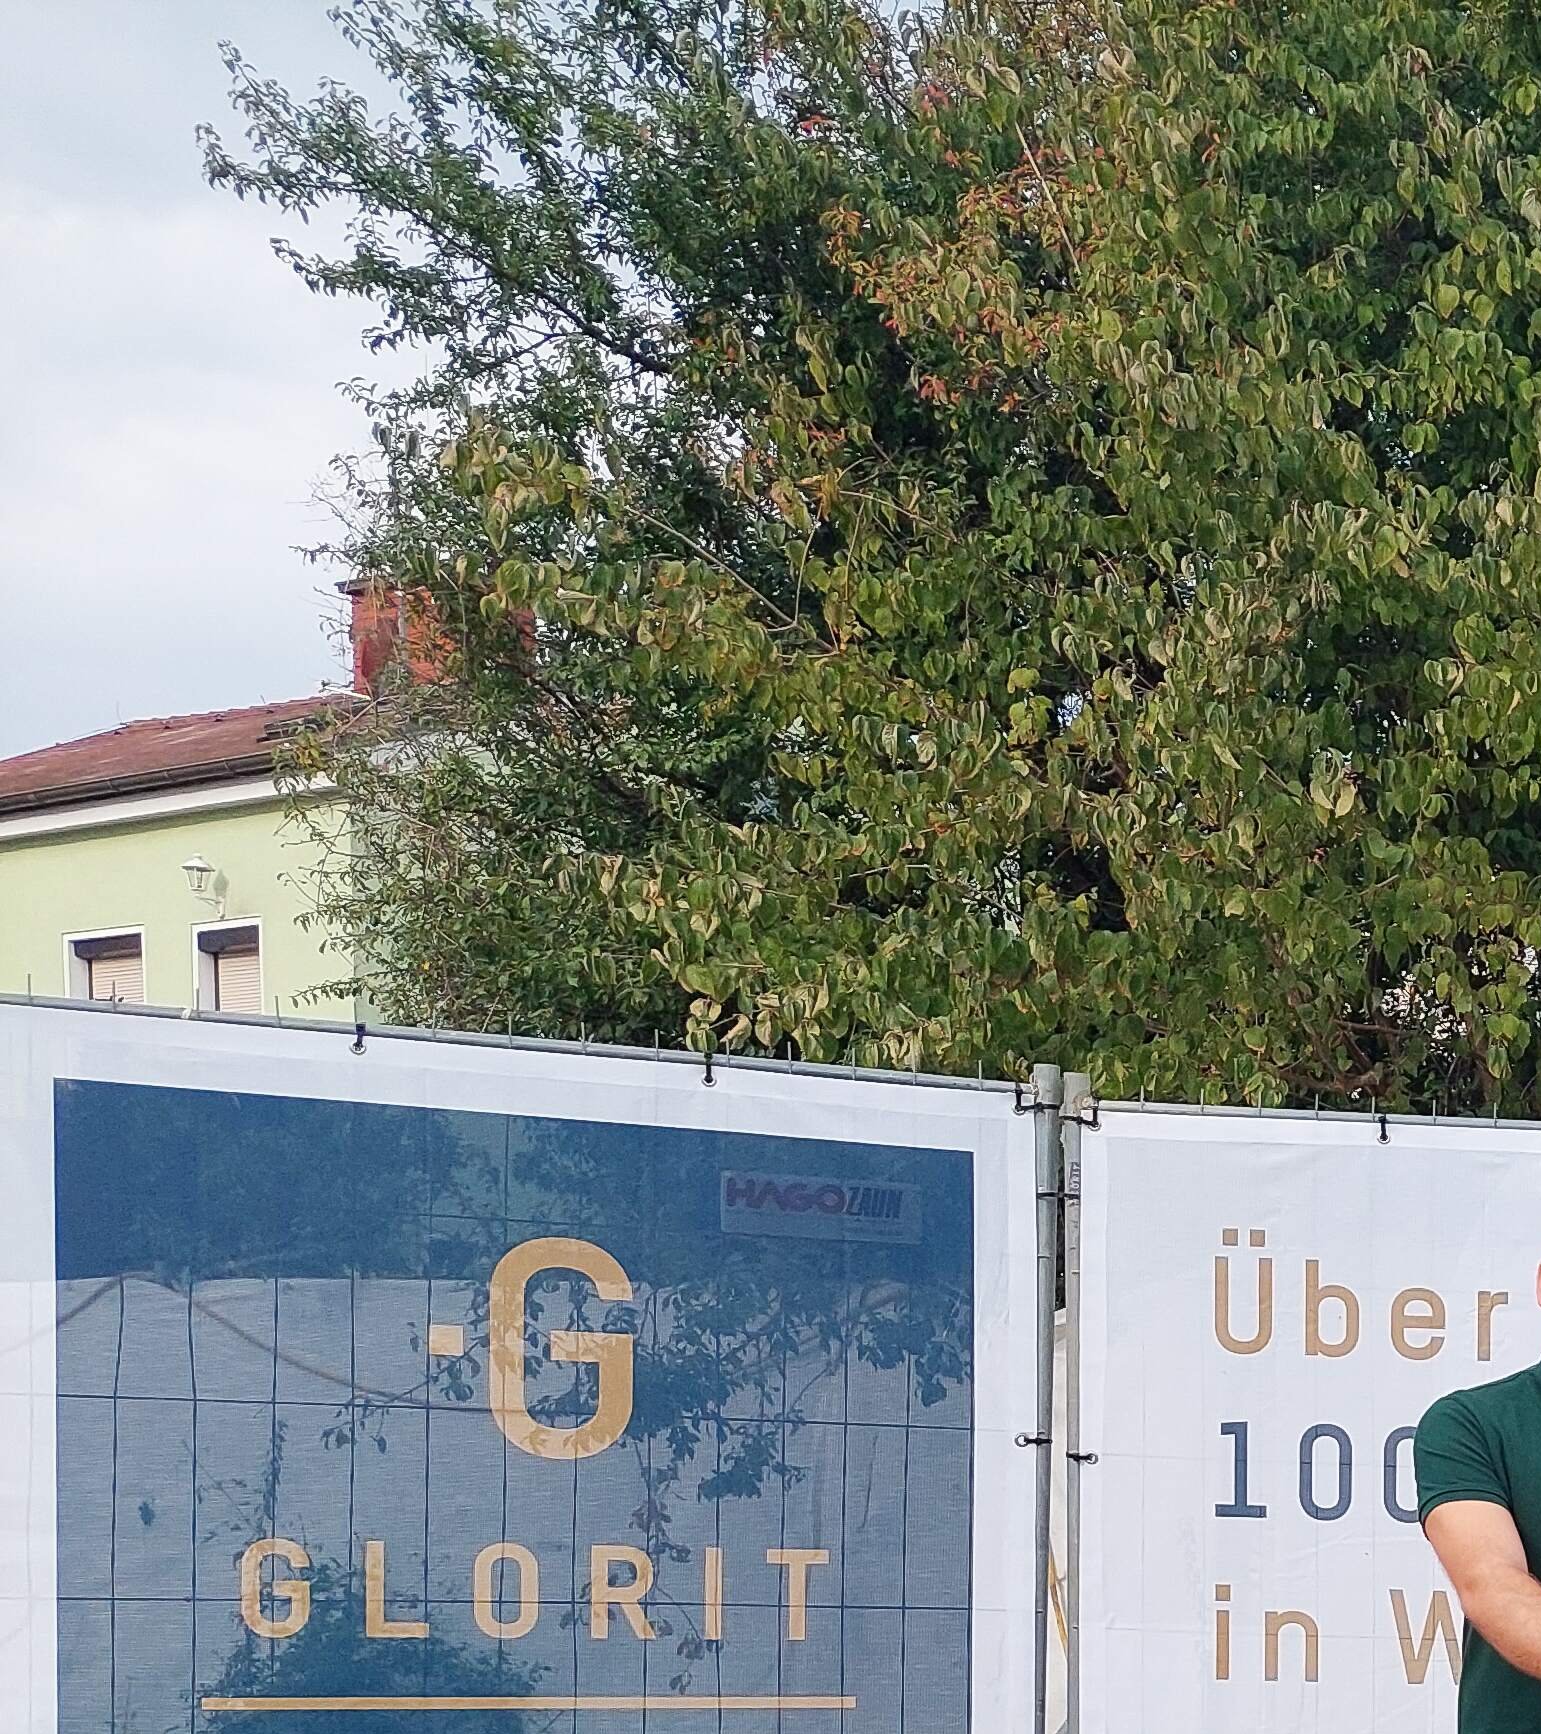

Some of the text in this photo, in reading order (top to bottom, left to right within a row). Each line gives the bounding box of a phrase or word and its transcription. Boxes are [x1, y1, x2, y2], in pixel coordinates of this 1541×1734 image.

[1214, 1227, 1509, 1361] Über
[238, 1537, 830, 1643] GLORIT
[1214, 1583, 1320, 1683] in
